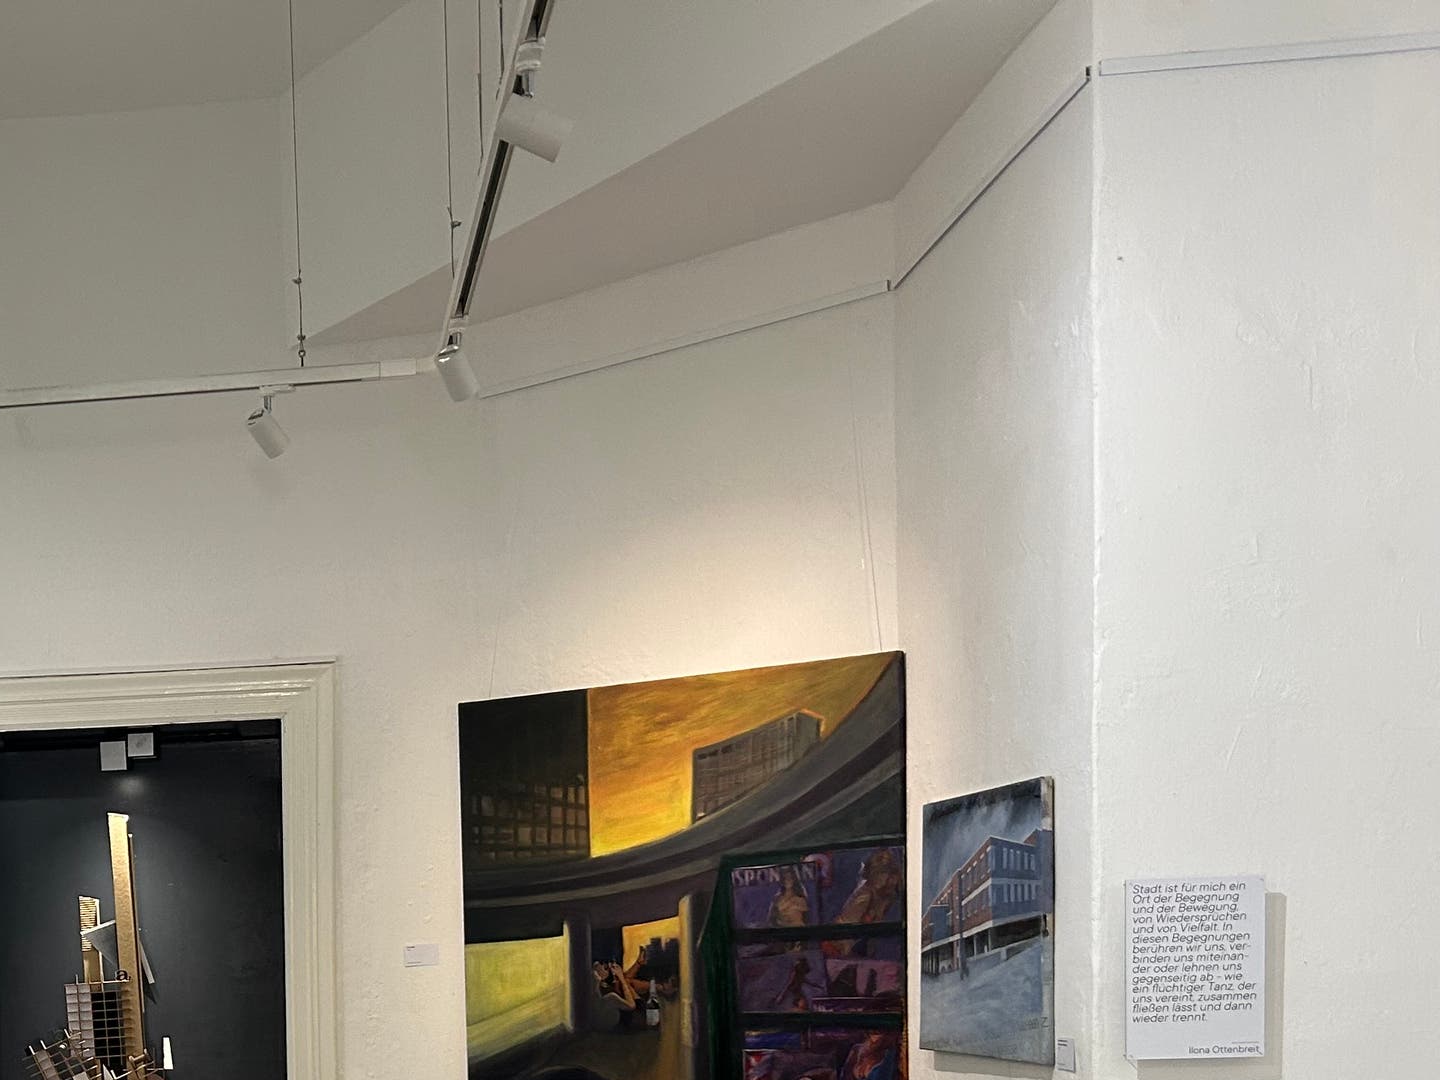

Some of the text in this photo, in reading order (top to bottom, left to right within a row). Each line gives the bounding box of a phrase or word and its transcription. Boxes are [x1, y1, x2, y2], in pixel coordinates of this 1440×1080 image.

[1132, 882, 1246, 894] Stadt ist für mich ein
[1132, 893, 1240, 904] Ort der Begegnung
[1132, 904, 1154, 914] und
[1157, 904, 1176, 914] der
[1132, 912, 1247, 924] von Wiedersprüchen
[1132, 924, 1154, 934] und
[1157, 925, 1177, 934] von
[1222, 922, 1233, 931] In
[1132, 932, 1250, 944] diesen Begegnungen
[1132, 943, 1183, 954] berühren
[1185, 944, 1202, 953] wir
[1229, 942, 1252, 951] ver-
[1132, 952, 1249, 964] binden uns miteinan-
[1132, 962, 1243, 974] der oder lehnen uns
[1132, 973, 1197, 985] gegenseitig
[1199, 972, 1214, 982] ab
[1224, 972, 1243, 981] wie
[1132, 985, 1149, 994] ein
[1152, 982, 1205, 994] flüchtiger
[1237, 981, 1257, 991] der
[1132, 995, 1152, 1004] uns
[1197, 992, 1257, 1002] zusammen
[1132, 1003, 1169, 1013] fließen
[1199, 1002, 1222, 1011] und
[1223, 1001, 1252, 1011] dann
[1132, 1012, 1208, 1023] wieder trennt.
[1188, 1045, 1260, 1054] Ilona Ottenbreit
